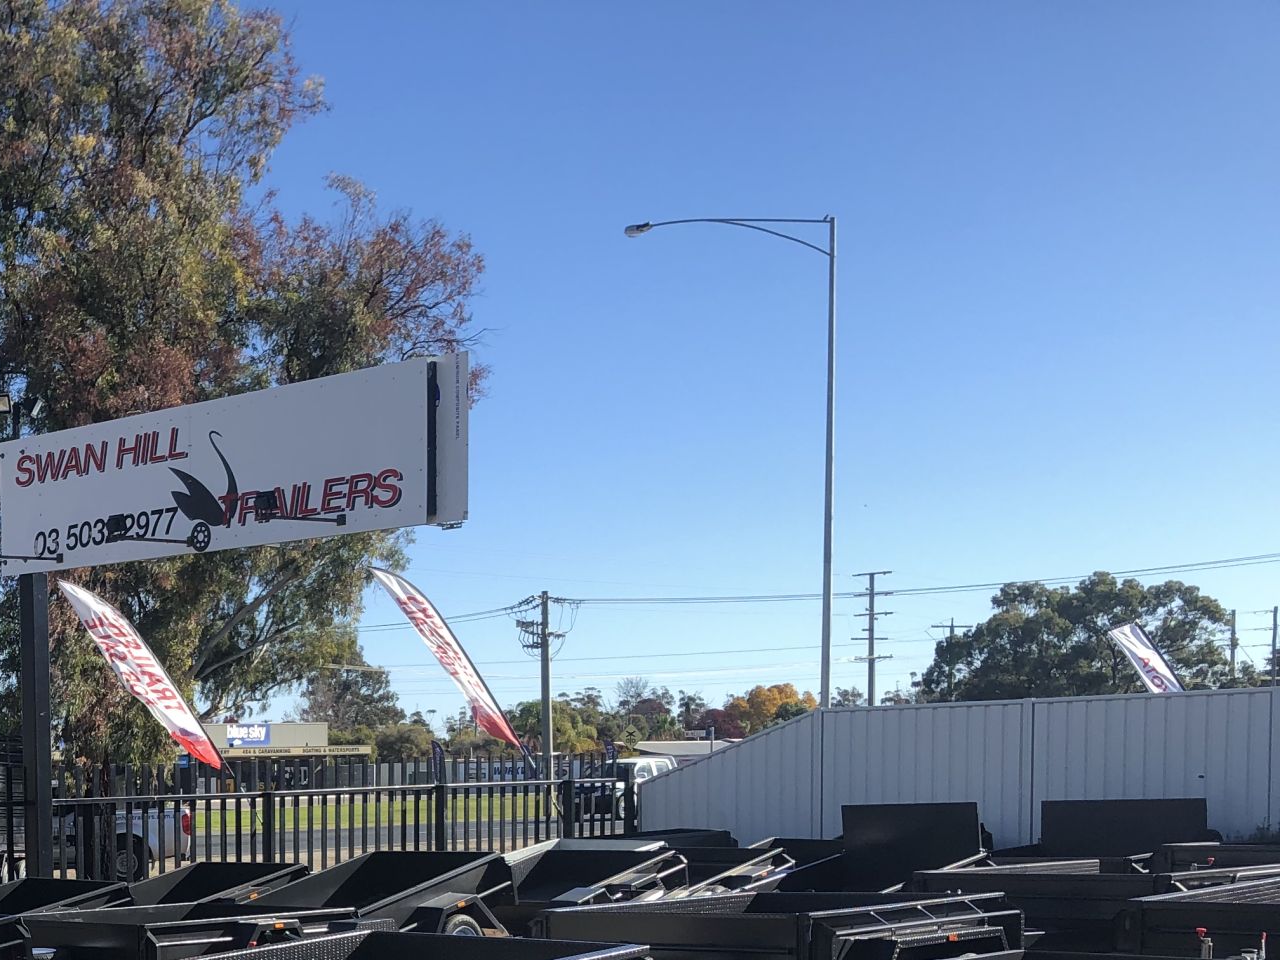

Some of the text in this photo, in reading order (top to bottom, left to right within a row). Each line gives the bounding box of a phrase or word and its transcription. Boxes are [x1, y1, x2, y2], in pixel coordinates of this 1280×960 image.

[15, 427, 188, 487] SWAN HILL
[34, 529, 60, 557] 03
[66, 515, 122, 550] 503
[226, 724, 266, 740] blue sky
